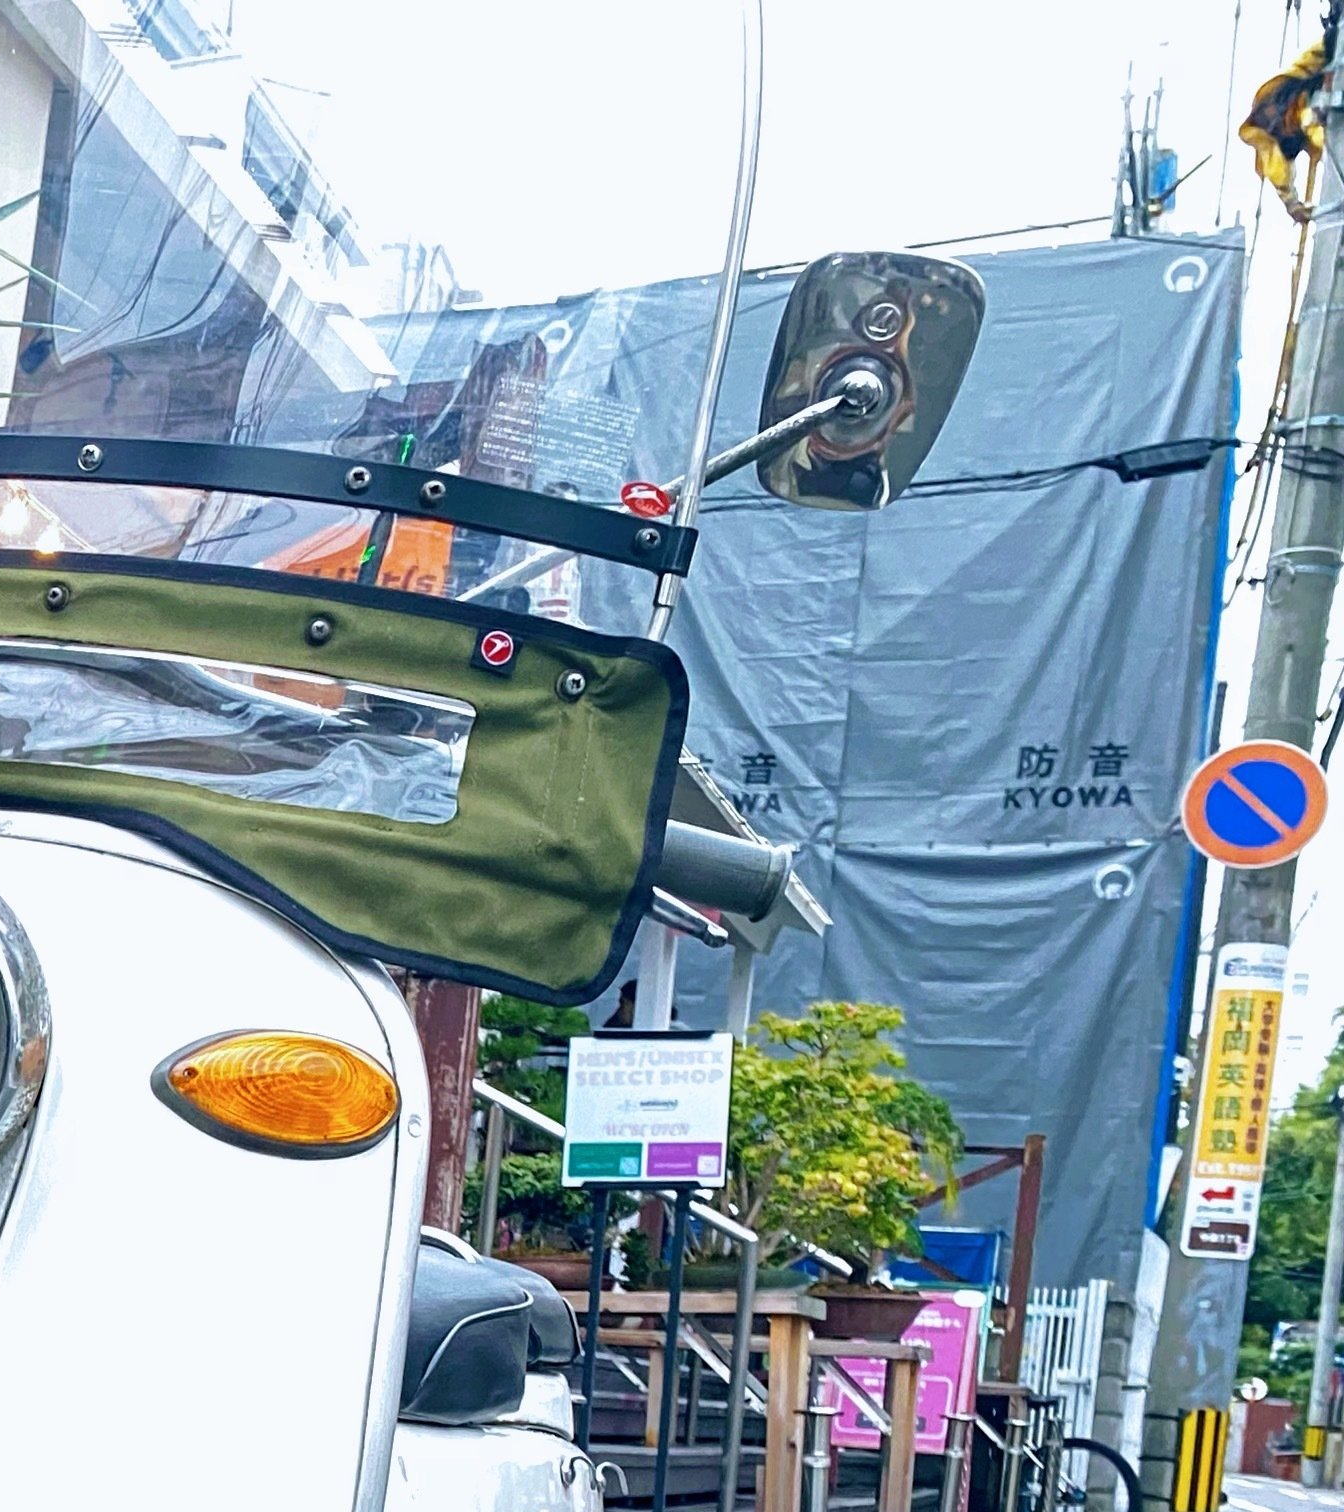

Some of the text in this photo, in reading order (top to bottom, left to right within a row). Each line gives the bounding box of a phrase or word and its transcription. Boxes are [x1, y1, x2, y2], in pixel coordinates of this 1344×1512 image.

[1002, 784, 1136, 810] KYOWA
[575, 1069, 724, 1087] SELECT SHOP
[1209, 996, 1256, 1154] 福岡英語塾
